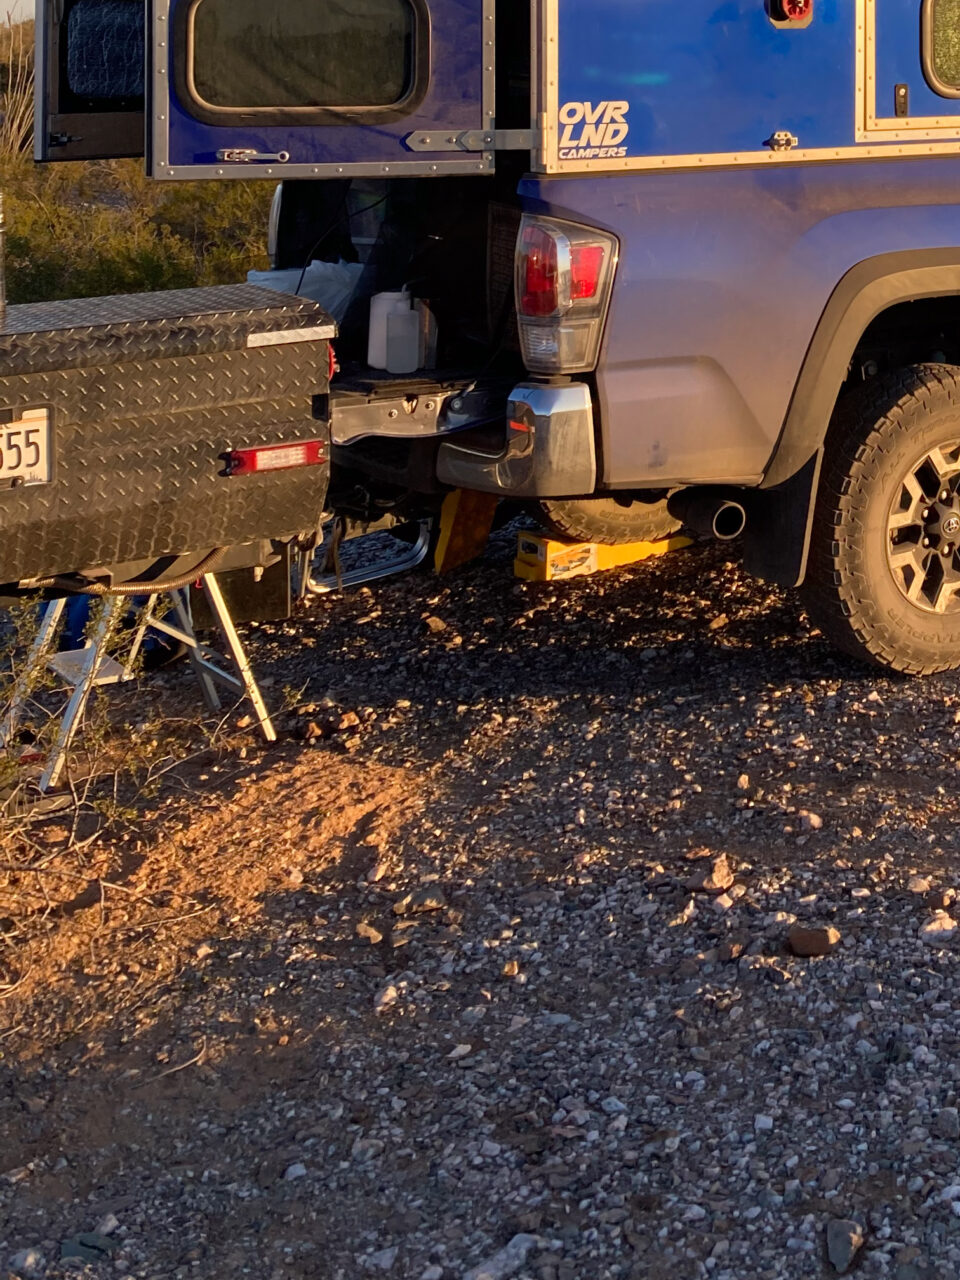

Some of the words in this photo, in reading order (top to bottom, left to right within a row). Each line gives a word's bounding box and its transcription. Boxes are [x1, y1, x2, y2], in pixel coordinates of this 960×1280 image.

[560, 101, 629, 124] OVR
[560, 124, 628, 147] LND
[559, 146, 628, 159] CAMPERS
[0, 429, 40, 470] 55
